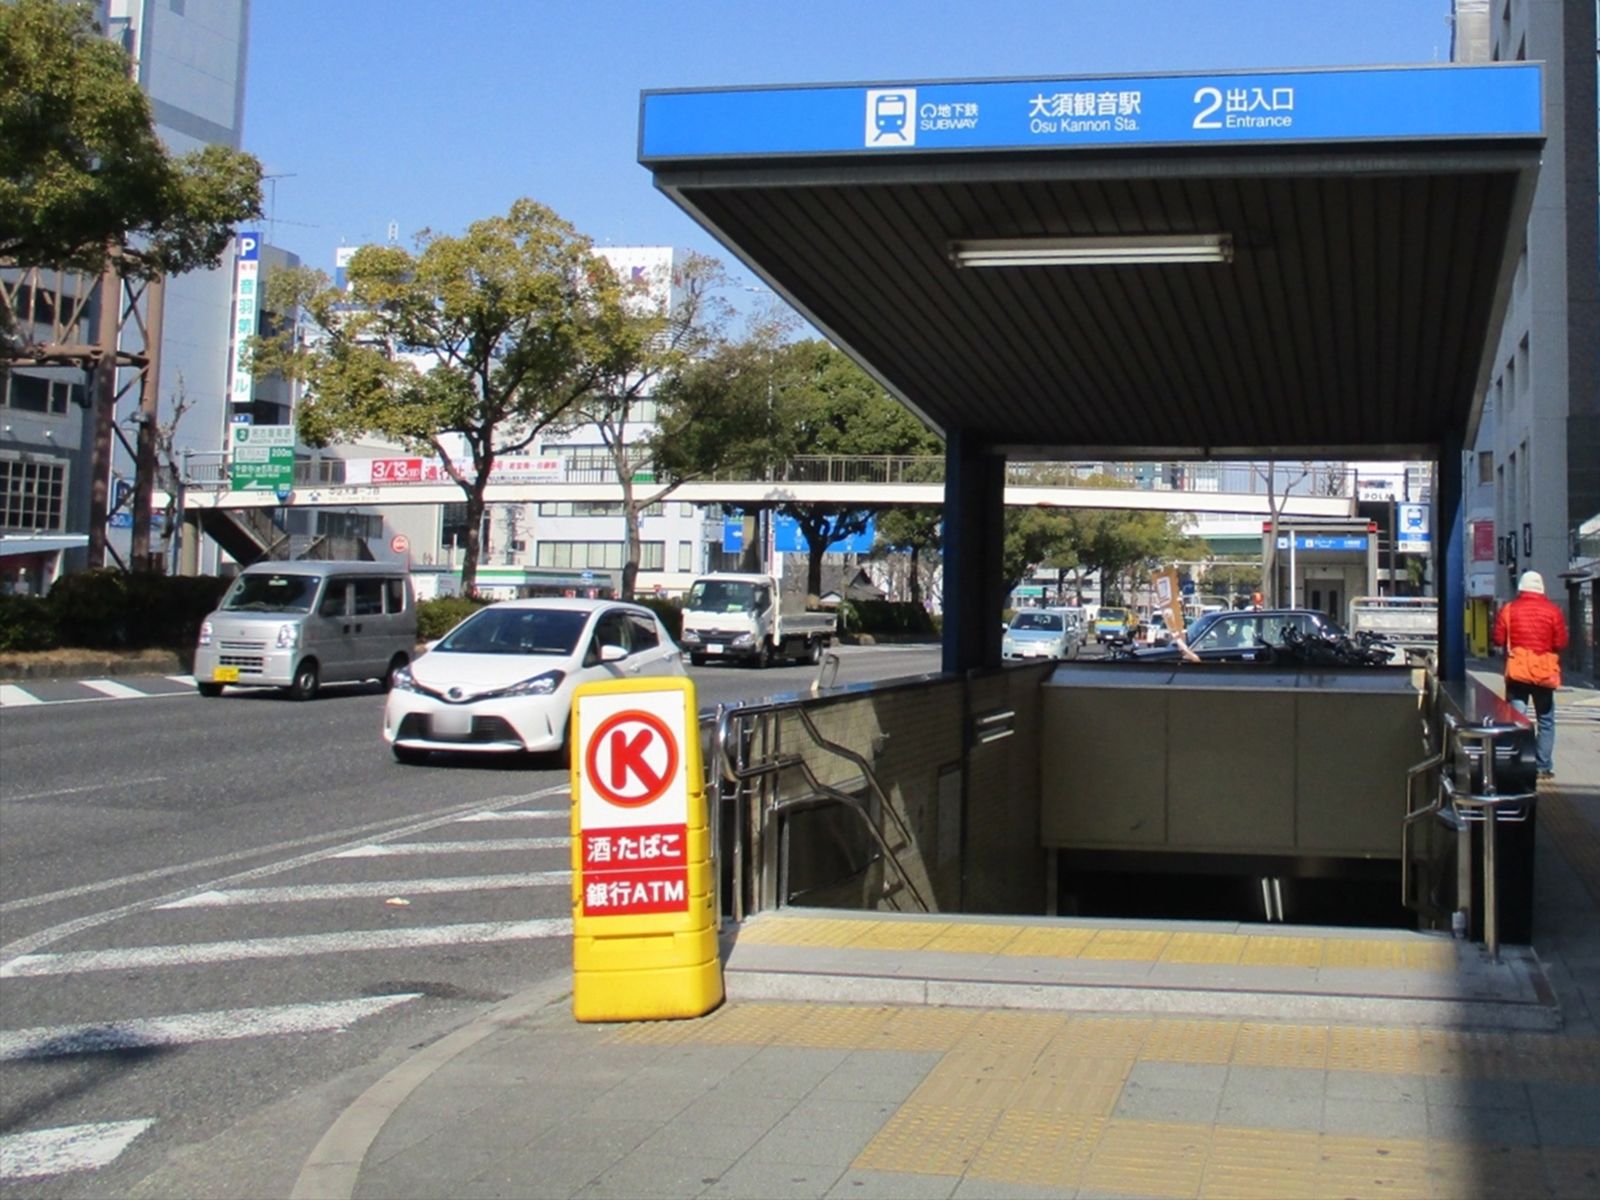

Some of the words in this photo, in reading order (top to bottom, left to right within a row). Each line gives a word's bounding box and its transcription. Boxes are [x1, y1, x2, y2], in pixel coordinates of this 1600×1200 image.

[937, 103, 979, 117] 地下鉄
[1029, 91, 1141, 118] 大須観音駅
[1193, 87, 1223, 129] 2
[1226, 88, 1294, 112] 出入口
[920, 118, 978, 131] SUBWAY
[1030, 121, 1057, 134] Osu
[1060, 119, 1111, 133] Kannon
[1113, 118, 1140, 132] Sta.
[1226, 114, 1293, 128] Entrance
[241, 238, 256, 257] P
[611, 729, 662, 793] K
[587, 880, 685, 908] 銀行ATM
